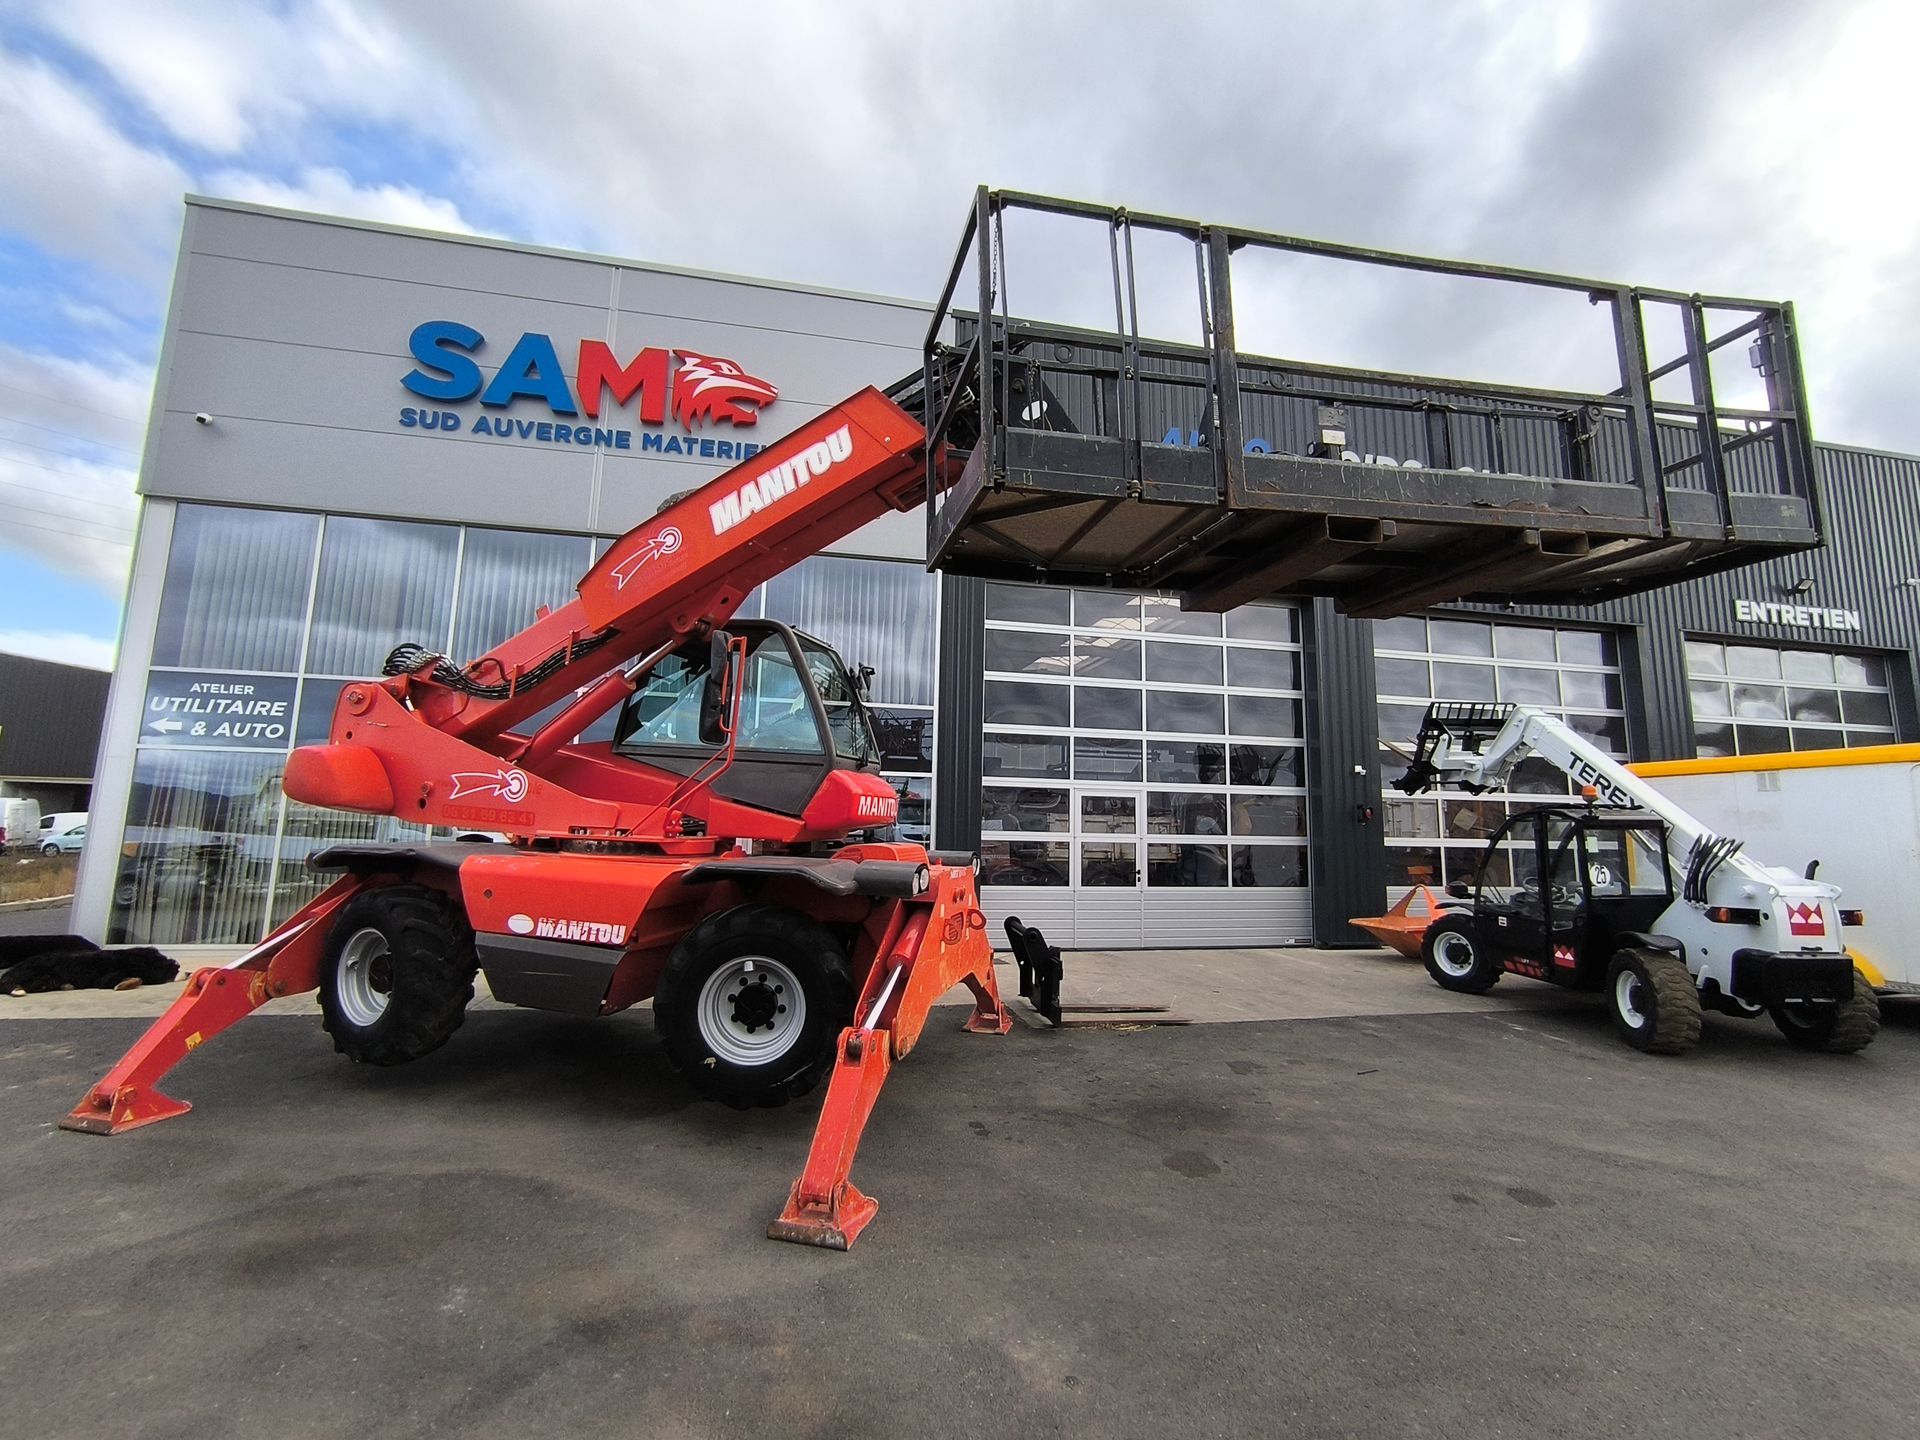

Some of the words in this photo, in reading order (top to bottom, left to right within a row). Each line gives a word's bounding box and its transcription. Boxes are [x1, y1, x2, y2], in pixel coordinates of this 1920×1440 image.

[400, 320, 669, 426] SAM
[398, 407, 462, 432] SUD
[472, 416, 632, 450] AUVERGNE
[642, 433, 767, 461] MATERIE
[708, 423, 854, 536] MANITOU
[1735, 599, 1860, 631] ENTRETIEN
[190, 683, 255, 695] ATELIER
[150, 696, 288, 717] UTILITAIRE
[190, 720, 207, 736] &
[212, 722, 285, 739] AUTO
[1594, 866, 1607, 884] 25
[536, 917, 627, 944] MANITOU
